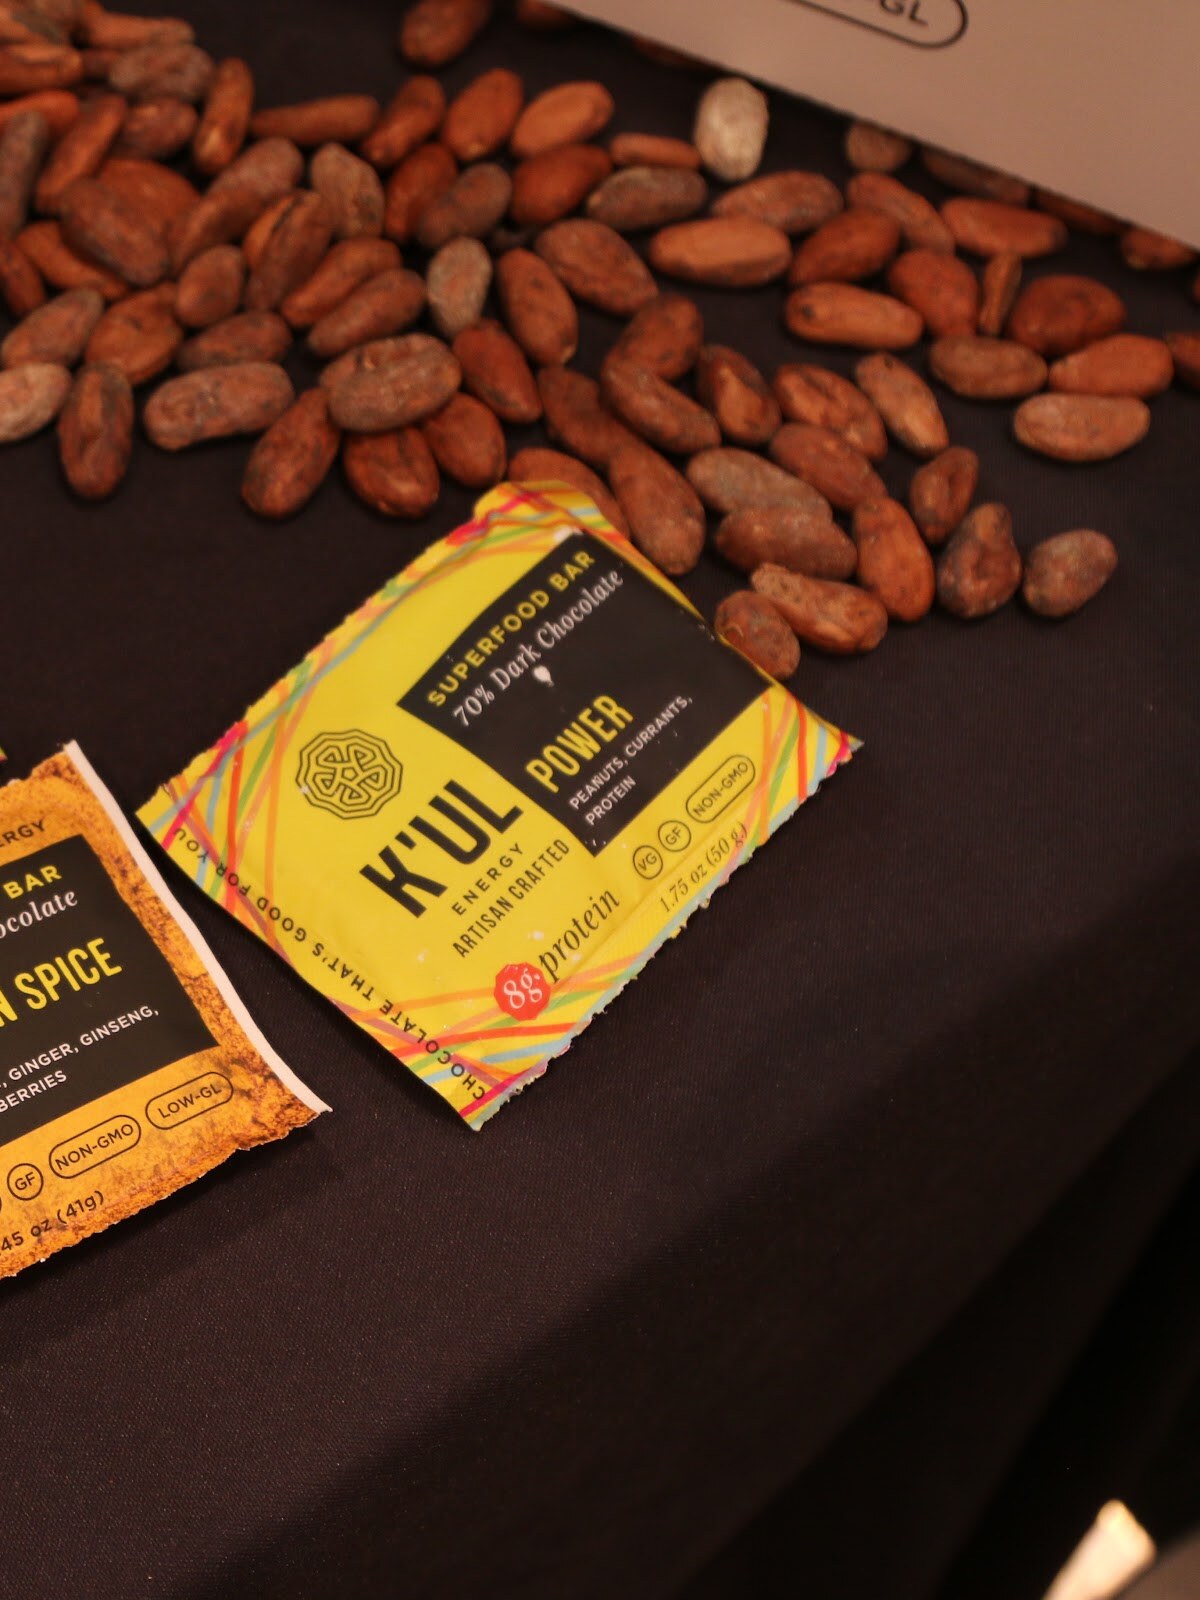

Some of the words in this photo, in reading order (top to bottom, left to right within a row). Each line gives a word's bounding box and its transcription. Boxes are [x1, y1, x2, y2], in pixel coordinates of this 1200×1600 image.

[426, 590, 551, 708] SUPERFOOD
[549, 550, 597, 593] BAR
[452, 684, 497, 728] 70%
[490, 644, 543, 692] Dark
[536, 569, 625, 650] Chocolate
[523, 694, 634, 794] POWER
[568, 757, 630, 812] PEANUTS,
[623, 694, 694, 759] CURRANTS,
[584, 776, 637, 827] PROTEIN
[638, 851, 659, 872] VG
[664, 825, 683, 847] GF
[692, 760, 750, 818] NON-GMO
[2, 864, 63, 897] BAR
[173, 827, 212, 865] YOU
[214, 864, 253, 898] FOR
[358, 779, 525, 920] K'UL
[450, 840, 526, 917] ENERGY
[658, 879, 691, 915] 1.75
[689, 863, 709, 885] oz
[705, 837, 731, 869] (50
[255, 895, 309, 945] GOOD
[451, 896, 515, 959] ARTISAN
[507, 839, 571, 900] CRAFTED
[13, 936, 123, 1011] SPICE
[310, 941, 378, 1004] THAT'S
[502, 967, 544, 1010] 8g
[537, 888, 621, 984] protein
[7, 1042, 81, 1083] GINGER,
[78, 1003, 161, 1048] GINSENG,
[379, 997, 488, 1102] CHOCOLATE
[13, 1171, 39, 1192] GF
[54, 1122, 136, 1171] NON-GMO
[156, 1082, 224, 1120] LOW-GL
[29, 1220, 52, 1240] oz
[56, 1189, 106, 1228] (41g)
